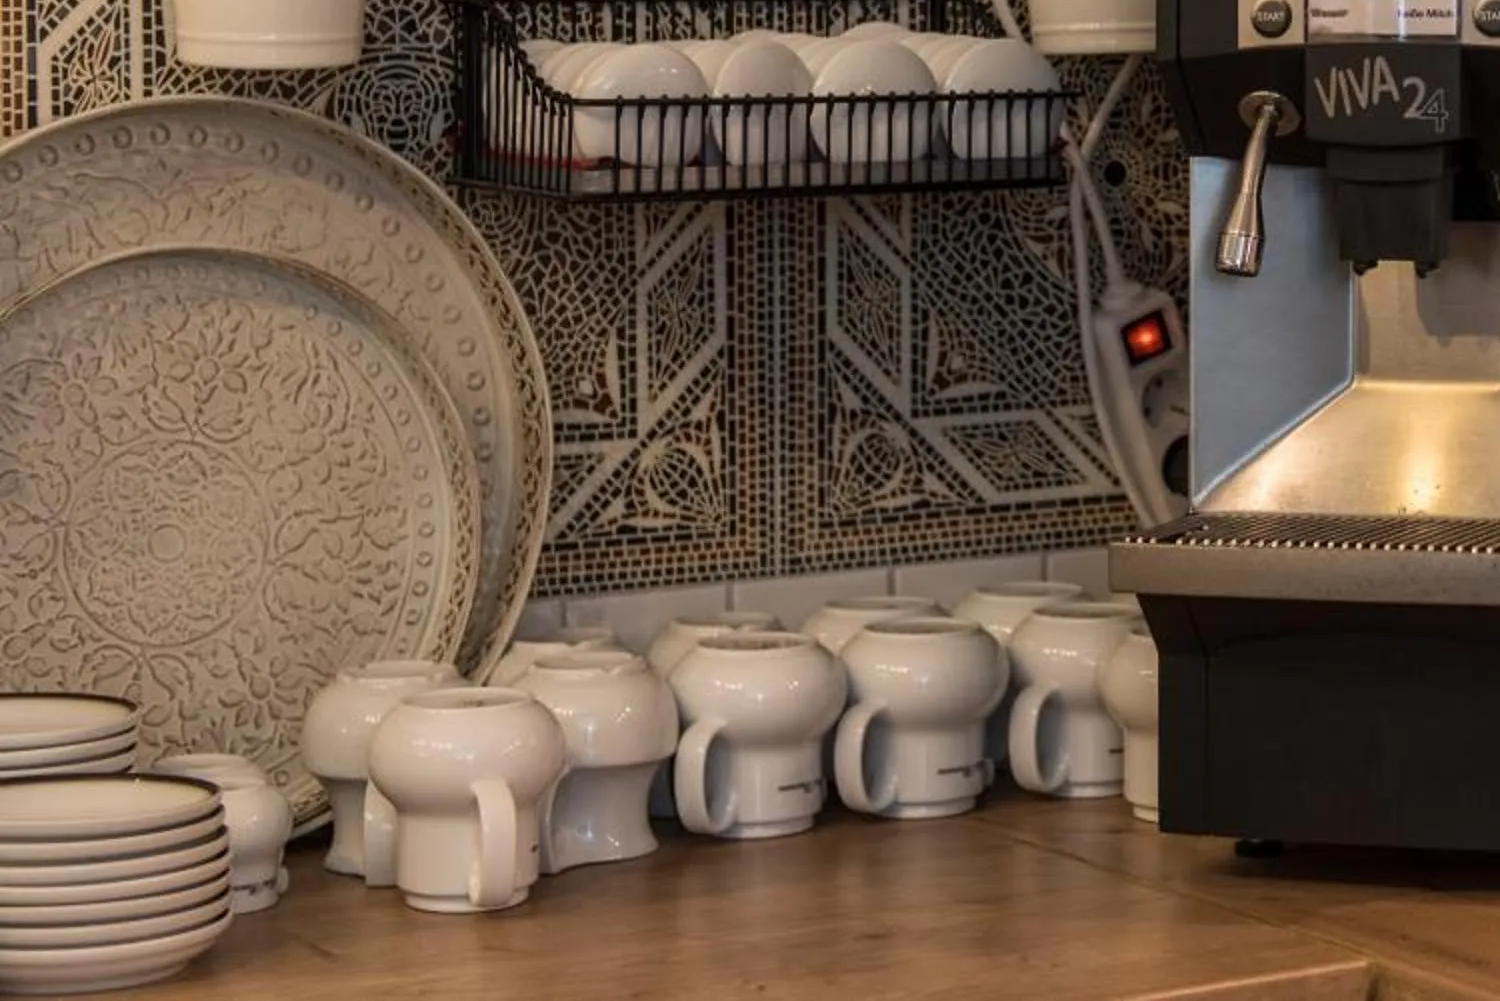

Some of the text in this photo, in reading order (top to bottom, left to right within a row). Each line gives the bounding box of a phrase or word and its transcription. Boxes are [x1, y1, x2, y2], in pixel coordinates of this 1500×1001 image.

[1257, 10, 1286, 22] START
[1314, 55, 1449, 134] VIVA 24
